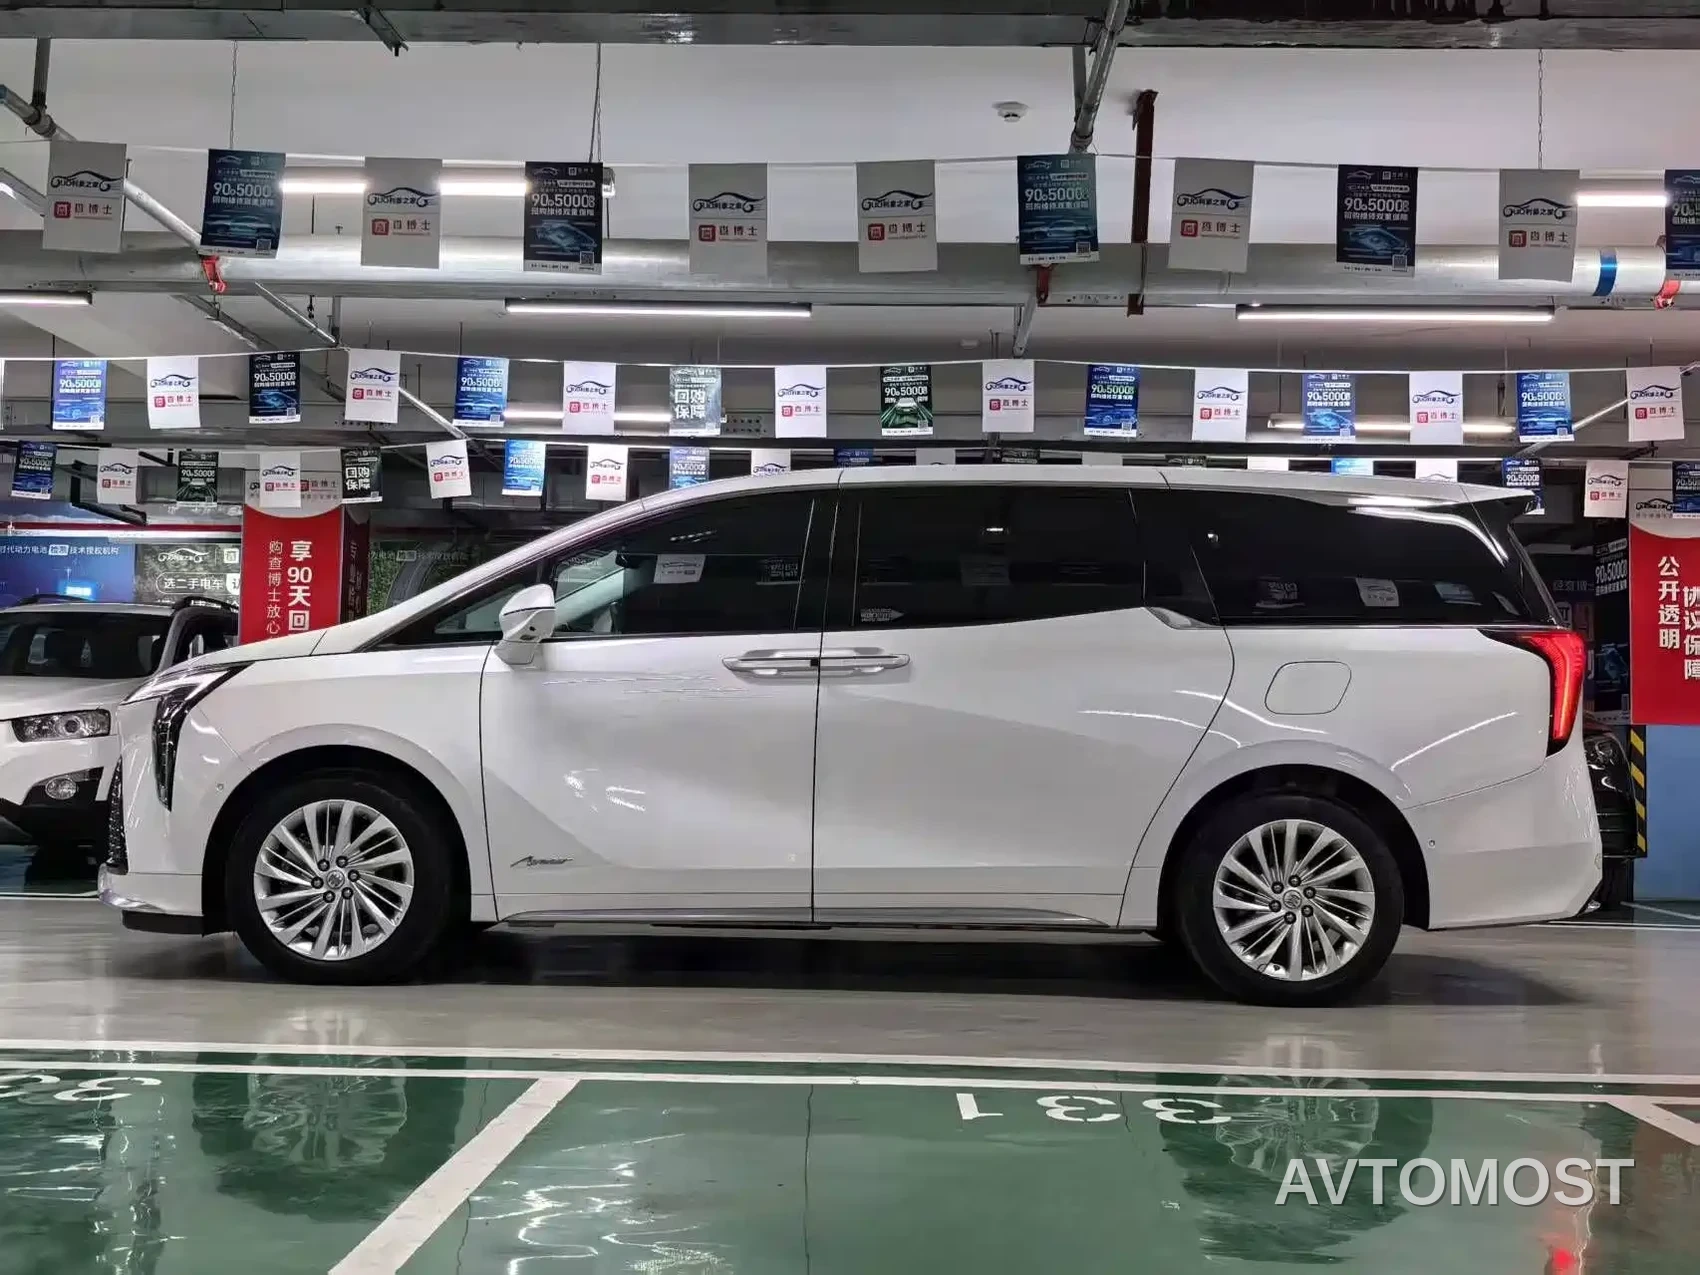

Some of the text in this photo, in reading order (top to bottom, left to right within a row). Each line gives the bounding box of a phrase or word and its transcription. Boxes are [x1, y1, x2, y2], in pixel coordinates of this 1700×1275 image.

[674, 389, 706, 404] 回购
[674, 404, 707, 419] 保障
[345, 467, 370, 478] 回购
[346, 478, 370, 491] 保障
[164, 577, 224, 590] 选二手电车
[1658, 556, 1680, 650] 公开透明
